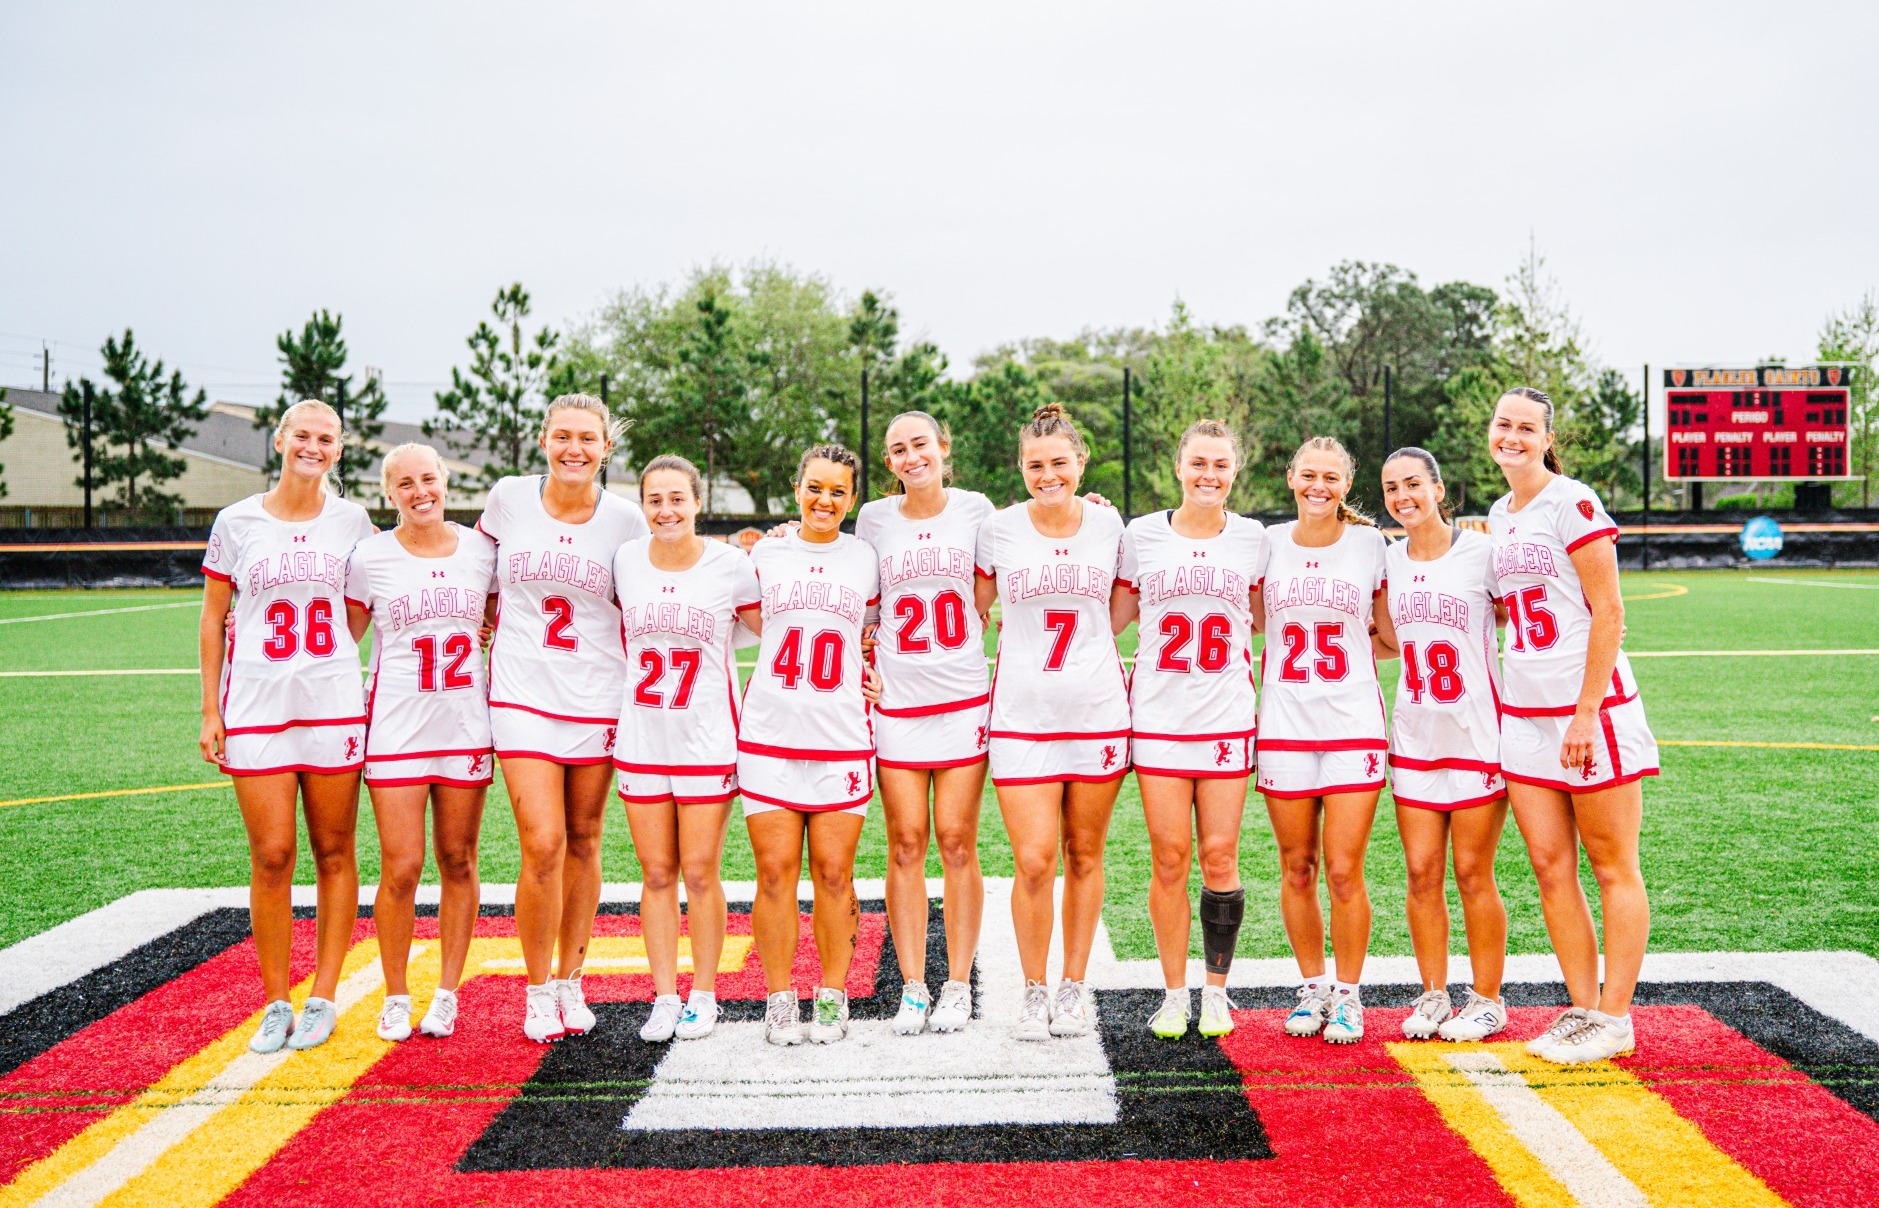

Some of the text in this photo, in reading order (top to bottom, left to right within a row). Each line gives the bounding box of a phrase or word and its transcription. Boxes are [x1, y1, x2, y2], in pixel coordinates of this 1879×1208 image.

[1692, 369, 1759, 386] FLAGLER
[1764, 369, 1820, 386] SAINTS
[1672, 431, 1845, 443] PLAYER PENALTY PLAYER PENALTY
[1731, 411, 1769, 424] PERIOD
[508, 551, 610, 598] FLAGLER
[1496, 542, 1559, 583] AGLER
[262, 597, 338, 662] 36
[541, 595, 579, 652] 2
[893, 589, 970, 654] 20
[1043, 609, 1079, 672] 7
[1156, 612, 1232, 674] 26
[1502, 584, 1560, 653] 15
[412, 632, 474, 692] 12
[634, 647, 703, 709] 27
[771, 626, 846, 693] 40
[1278, 621, 1350, 684] 25
[1402, 640, 1466, 704] 48
